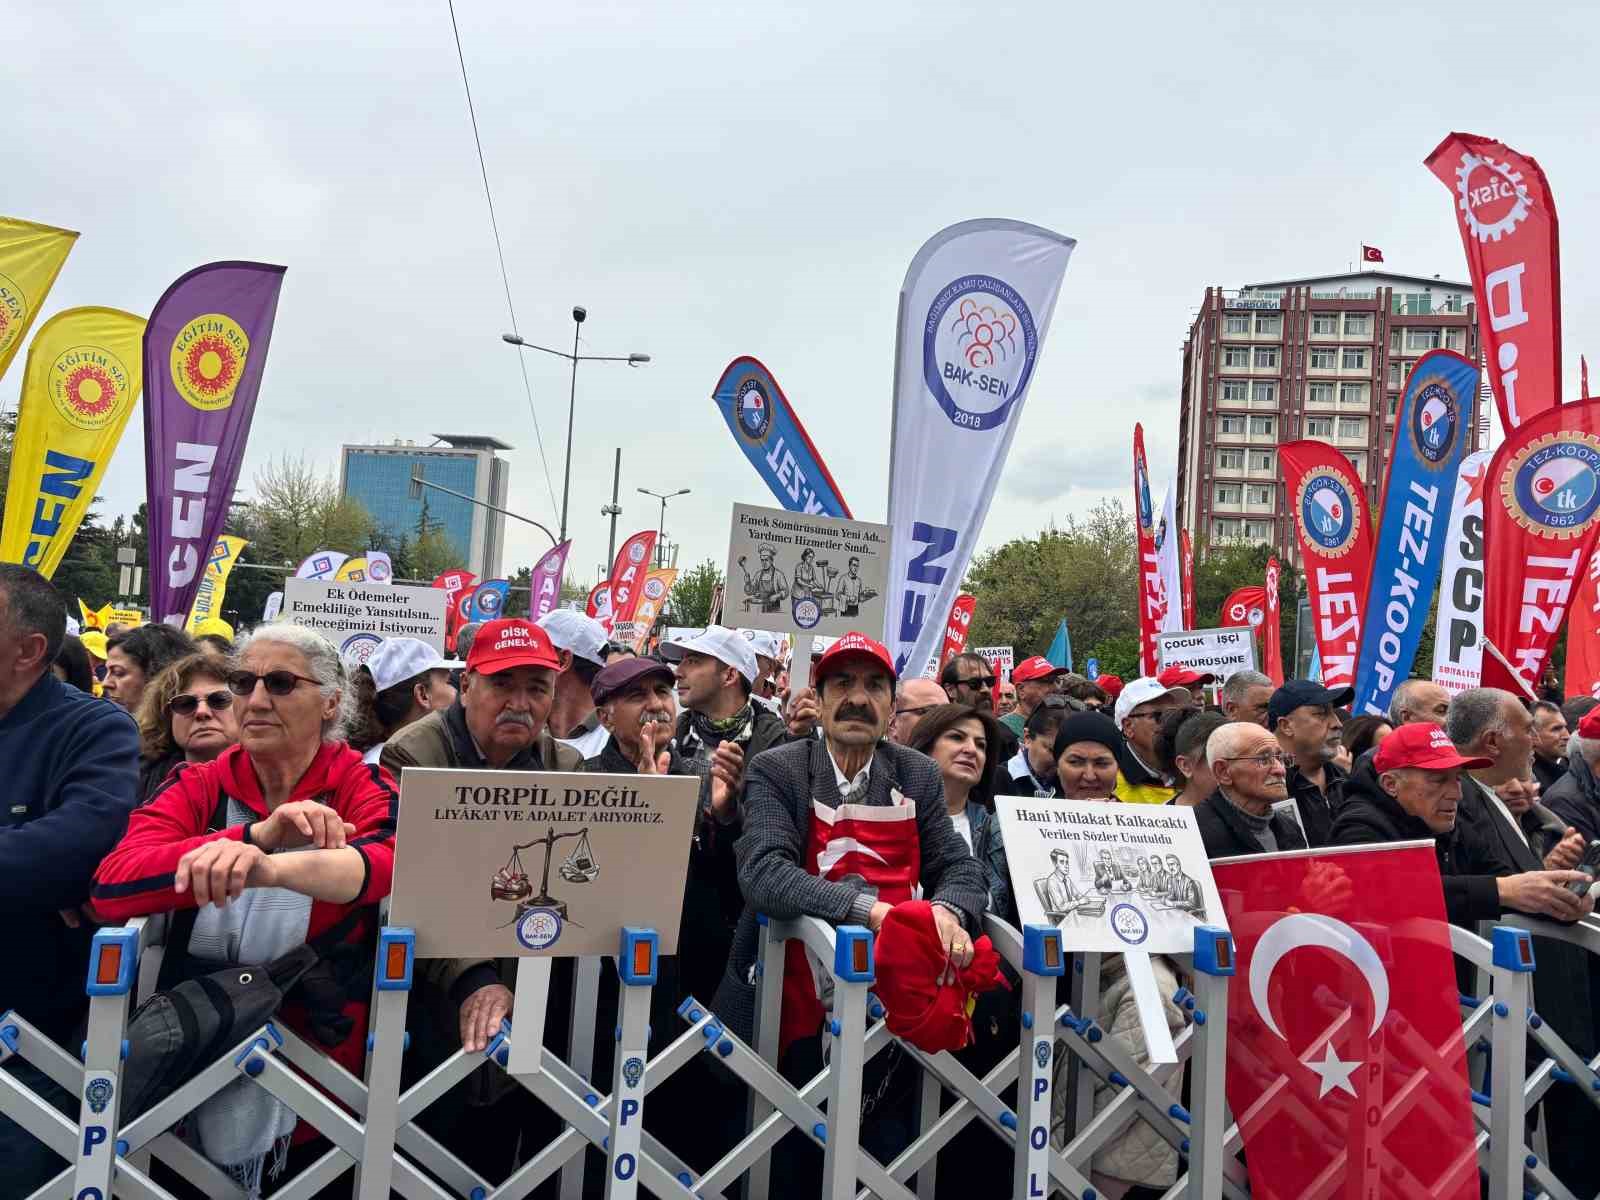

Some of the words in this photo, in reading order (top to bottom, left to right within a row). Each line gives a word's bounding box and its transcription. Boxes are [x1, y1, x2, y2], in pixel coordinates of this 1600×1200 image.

[944, 362, 1009, 399] BAK-SEN
[954, 411, 981, 428] 2018
[1556, 489, 1576, 509] tk
[740, 514, 770, 527] Emek
[840, 528, 861, 538] Yeni
[1544, 514, 1576, 526] 1962
[795, 535, 843, 551] Hizmetler
[327, 588, 345, 600] Ek
[1449, 514, 1483, 663] SCP
[292, 601, 362, 617] Emekliliğe
[294, 616, 376, 632] Geleceğimizi
[380, 620, 437, 636] İstiyoruz.
[501, 626, 530, 639] DİSK
[1165, 637, 1205, 650] ÇOCUK
[456, 784, 556, 807] TORPİL
[564, 786, 650, 808] DEĞİL.
[505, 810, 524, 821] VE
[527, 811, 587, 822] ADALET
[589, 812, 665, 824] ARIYORUZ.
[1016, 809, 1051, 823] Hani
[1053, 811, 1113, 827] Mülakat
[1115, 814, 1188, 830] Kalkacaktı
[1039, 828, 1081, 841] Verilen
[1083, 829, 1118, 843] Sözler
[1121, 832, 1173, 846] Unutuldu
[614, 1099, 639, 1180] PO
[1030, 1078, 1048, 1197] POL
